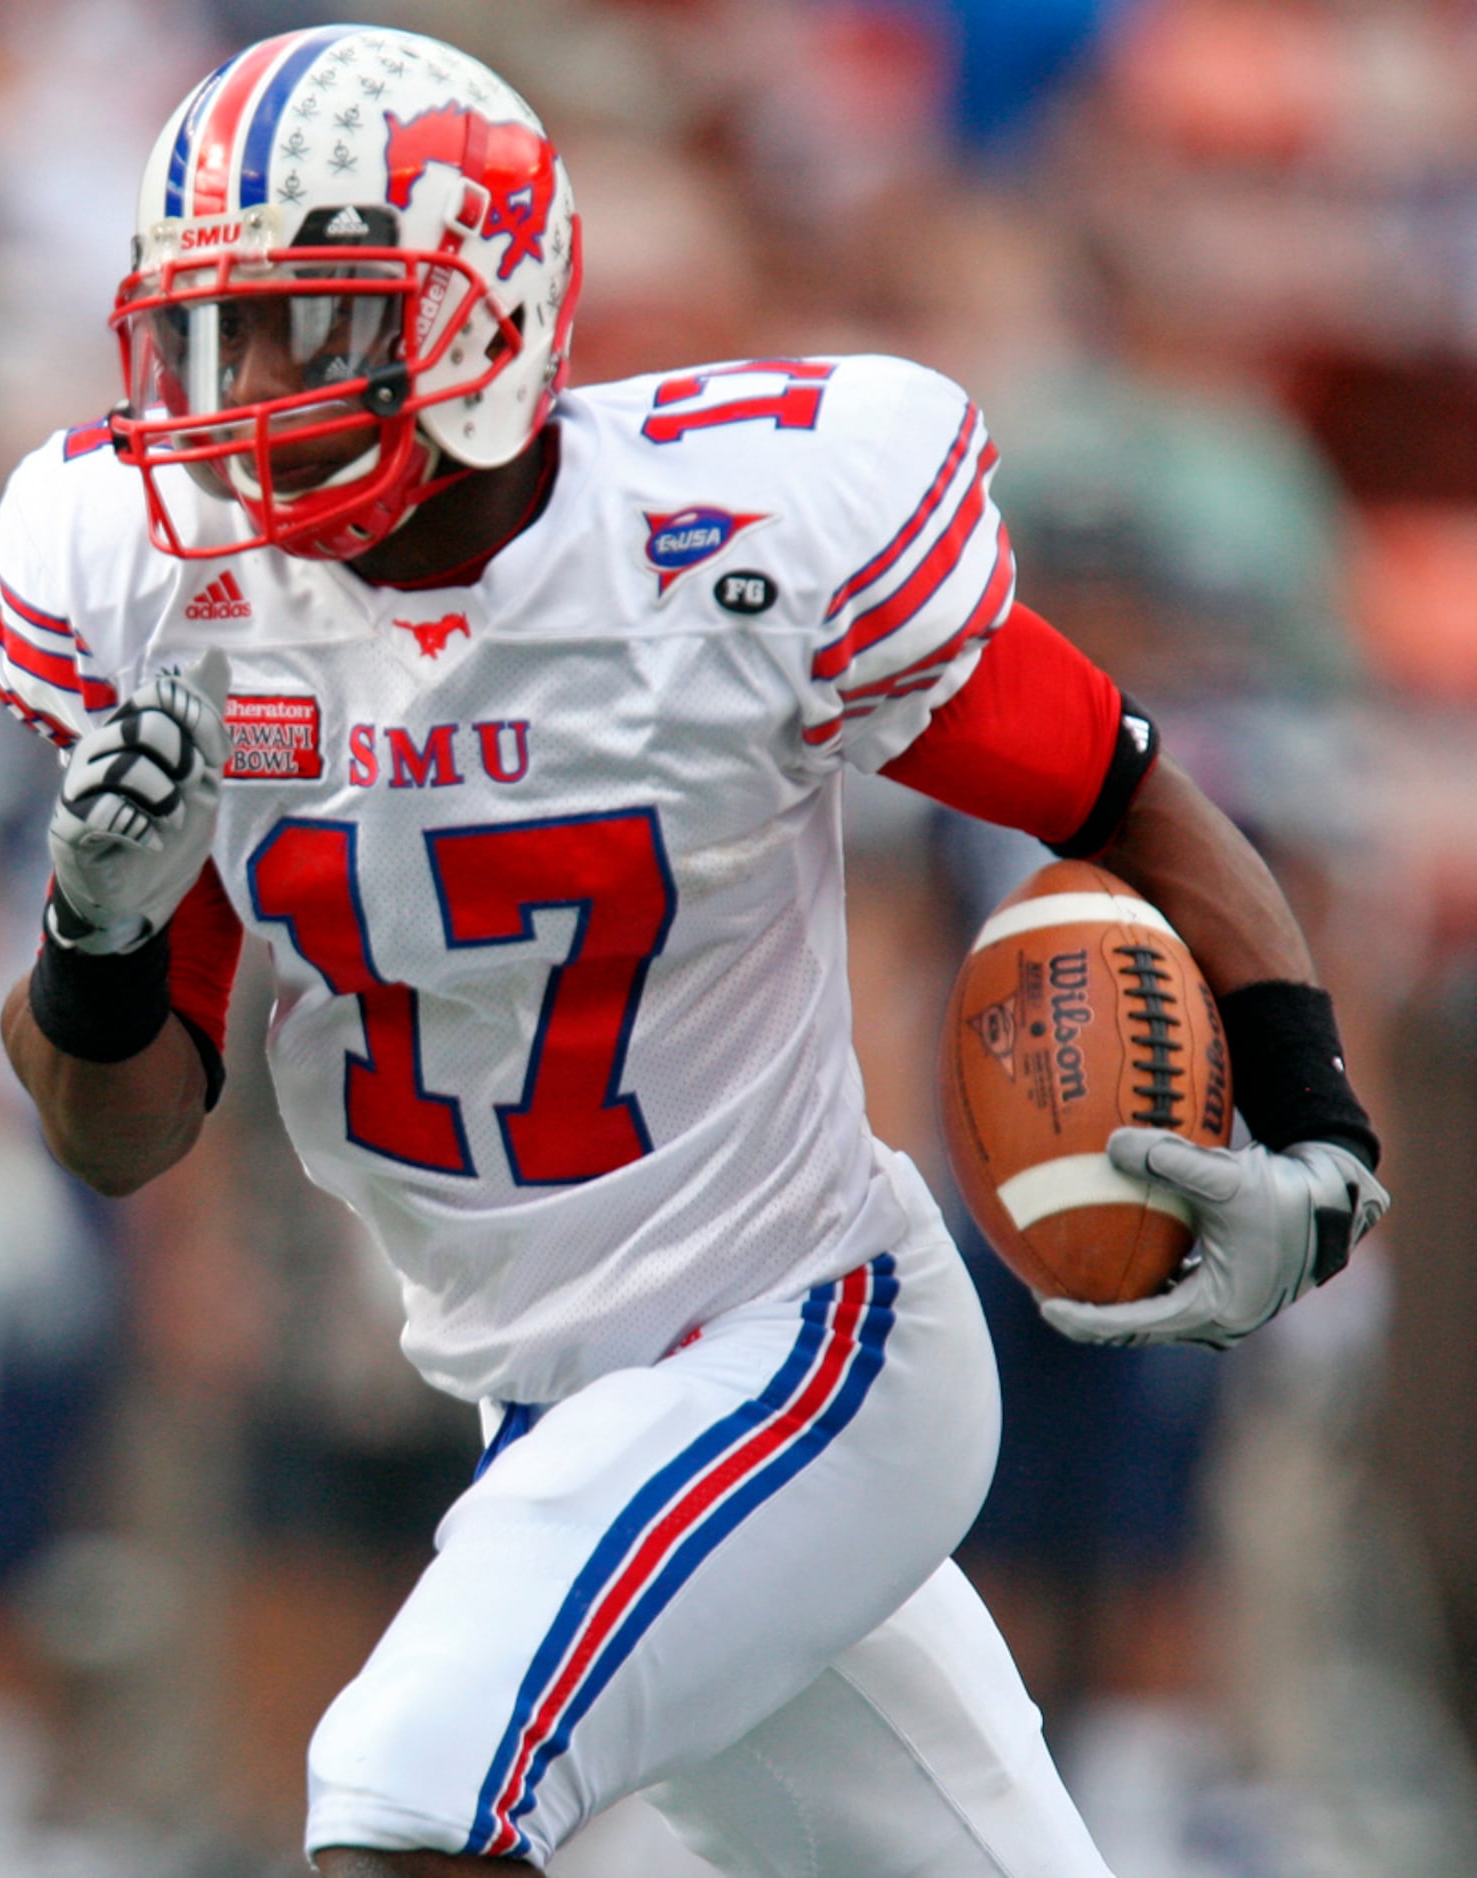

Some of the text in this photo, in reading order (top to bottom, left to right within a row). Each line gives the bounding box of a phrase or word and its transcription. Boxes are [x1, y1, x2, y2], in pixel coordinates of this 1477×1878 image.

[181, 222, 243, 249] SMU
[725, 577, 767, 605] FG
[185, 602, 252, 621] adidas
[233, 749, 298, 773] BOWL
[348, 720, 532, 788] SMU
[246, 804, 679, 1187] 17
[1049, 950, 1094, 1102] Wilson
